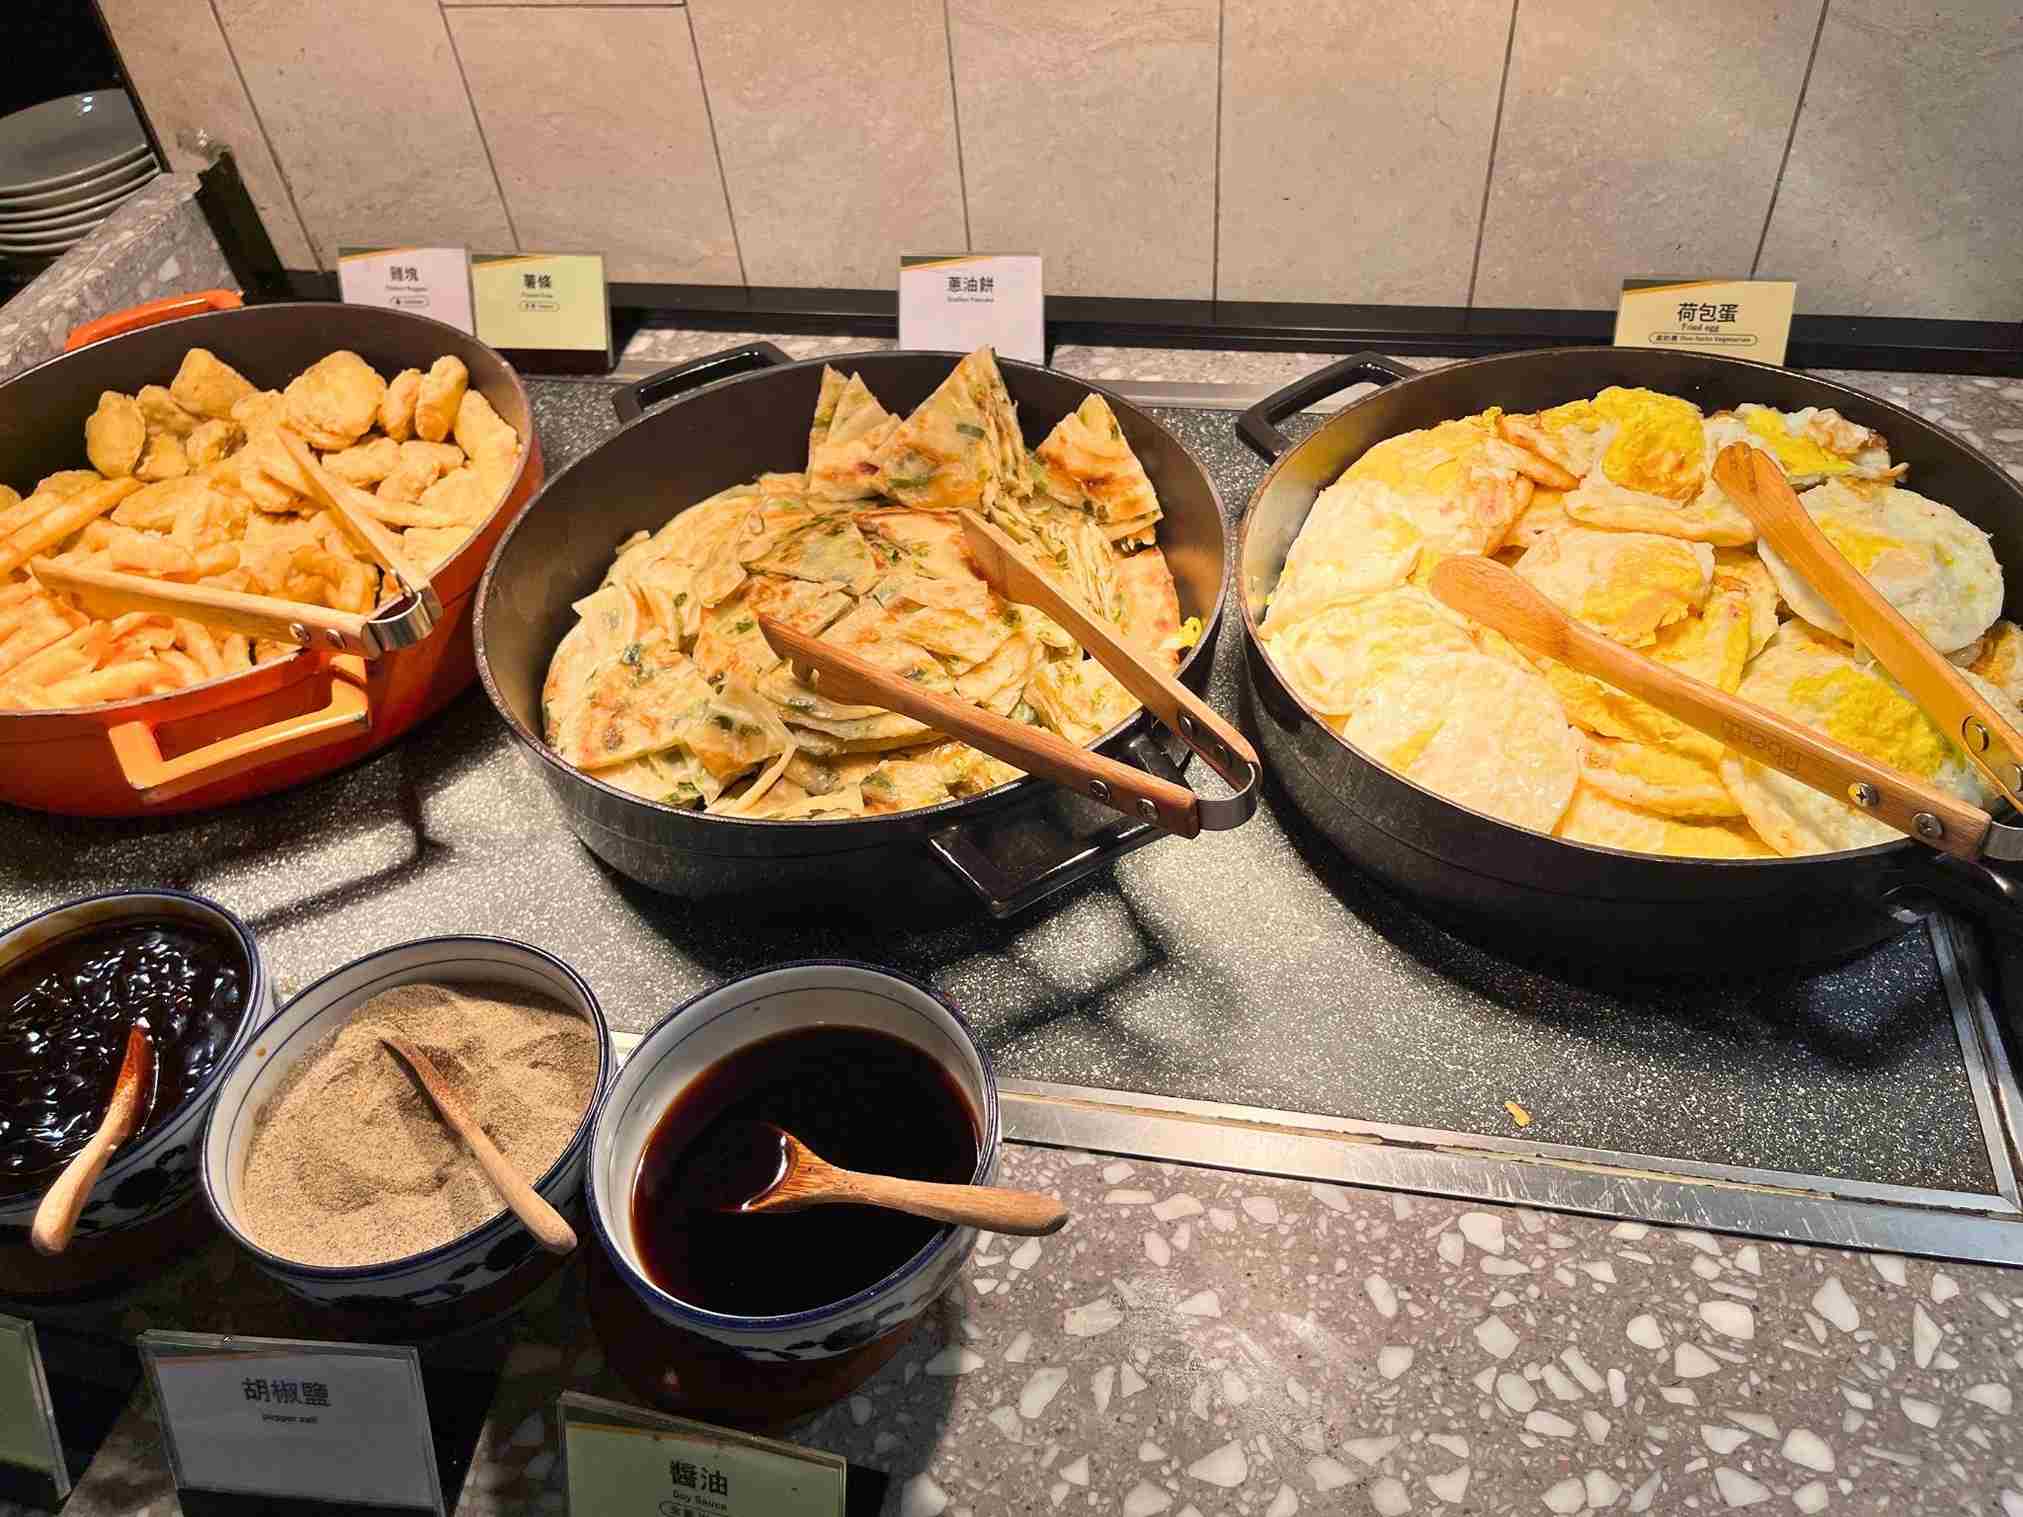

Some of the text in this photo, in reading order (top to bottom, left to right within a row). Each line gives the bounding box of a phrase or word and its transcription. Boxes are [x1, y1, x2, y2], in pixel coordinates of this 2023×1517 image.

[1677, 302, 1739, 323] 荷包蛋
[241, 1376, 332, 1408] 胡椒鹽
[669, 1459, 729, 1496] 醬油
